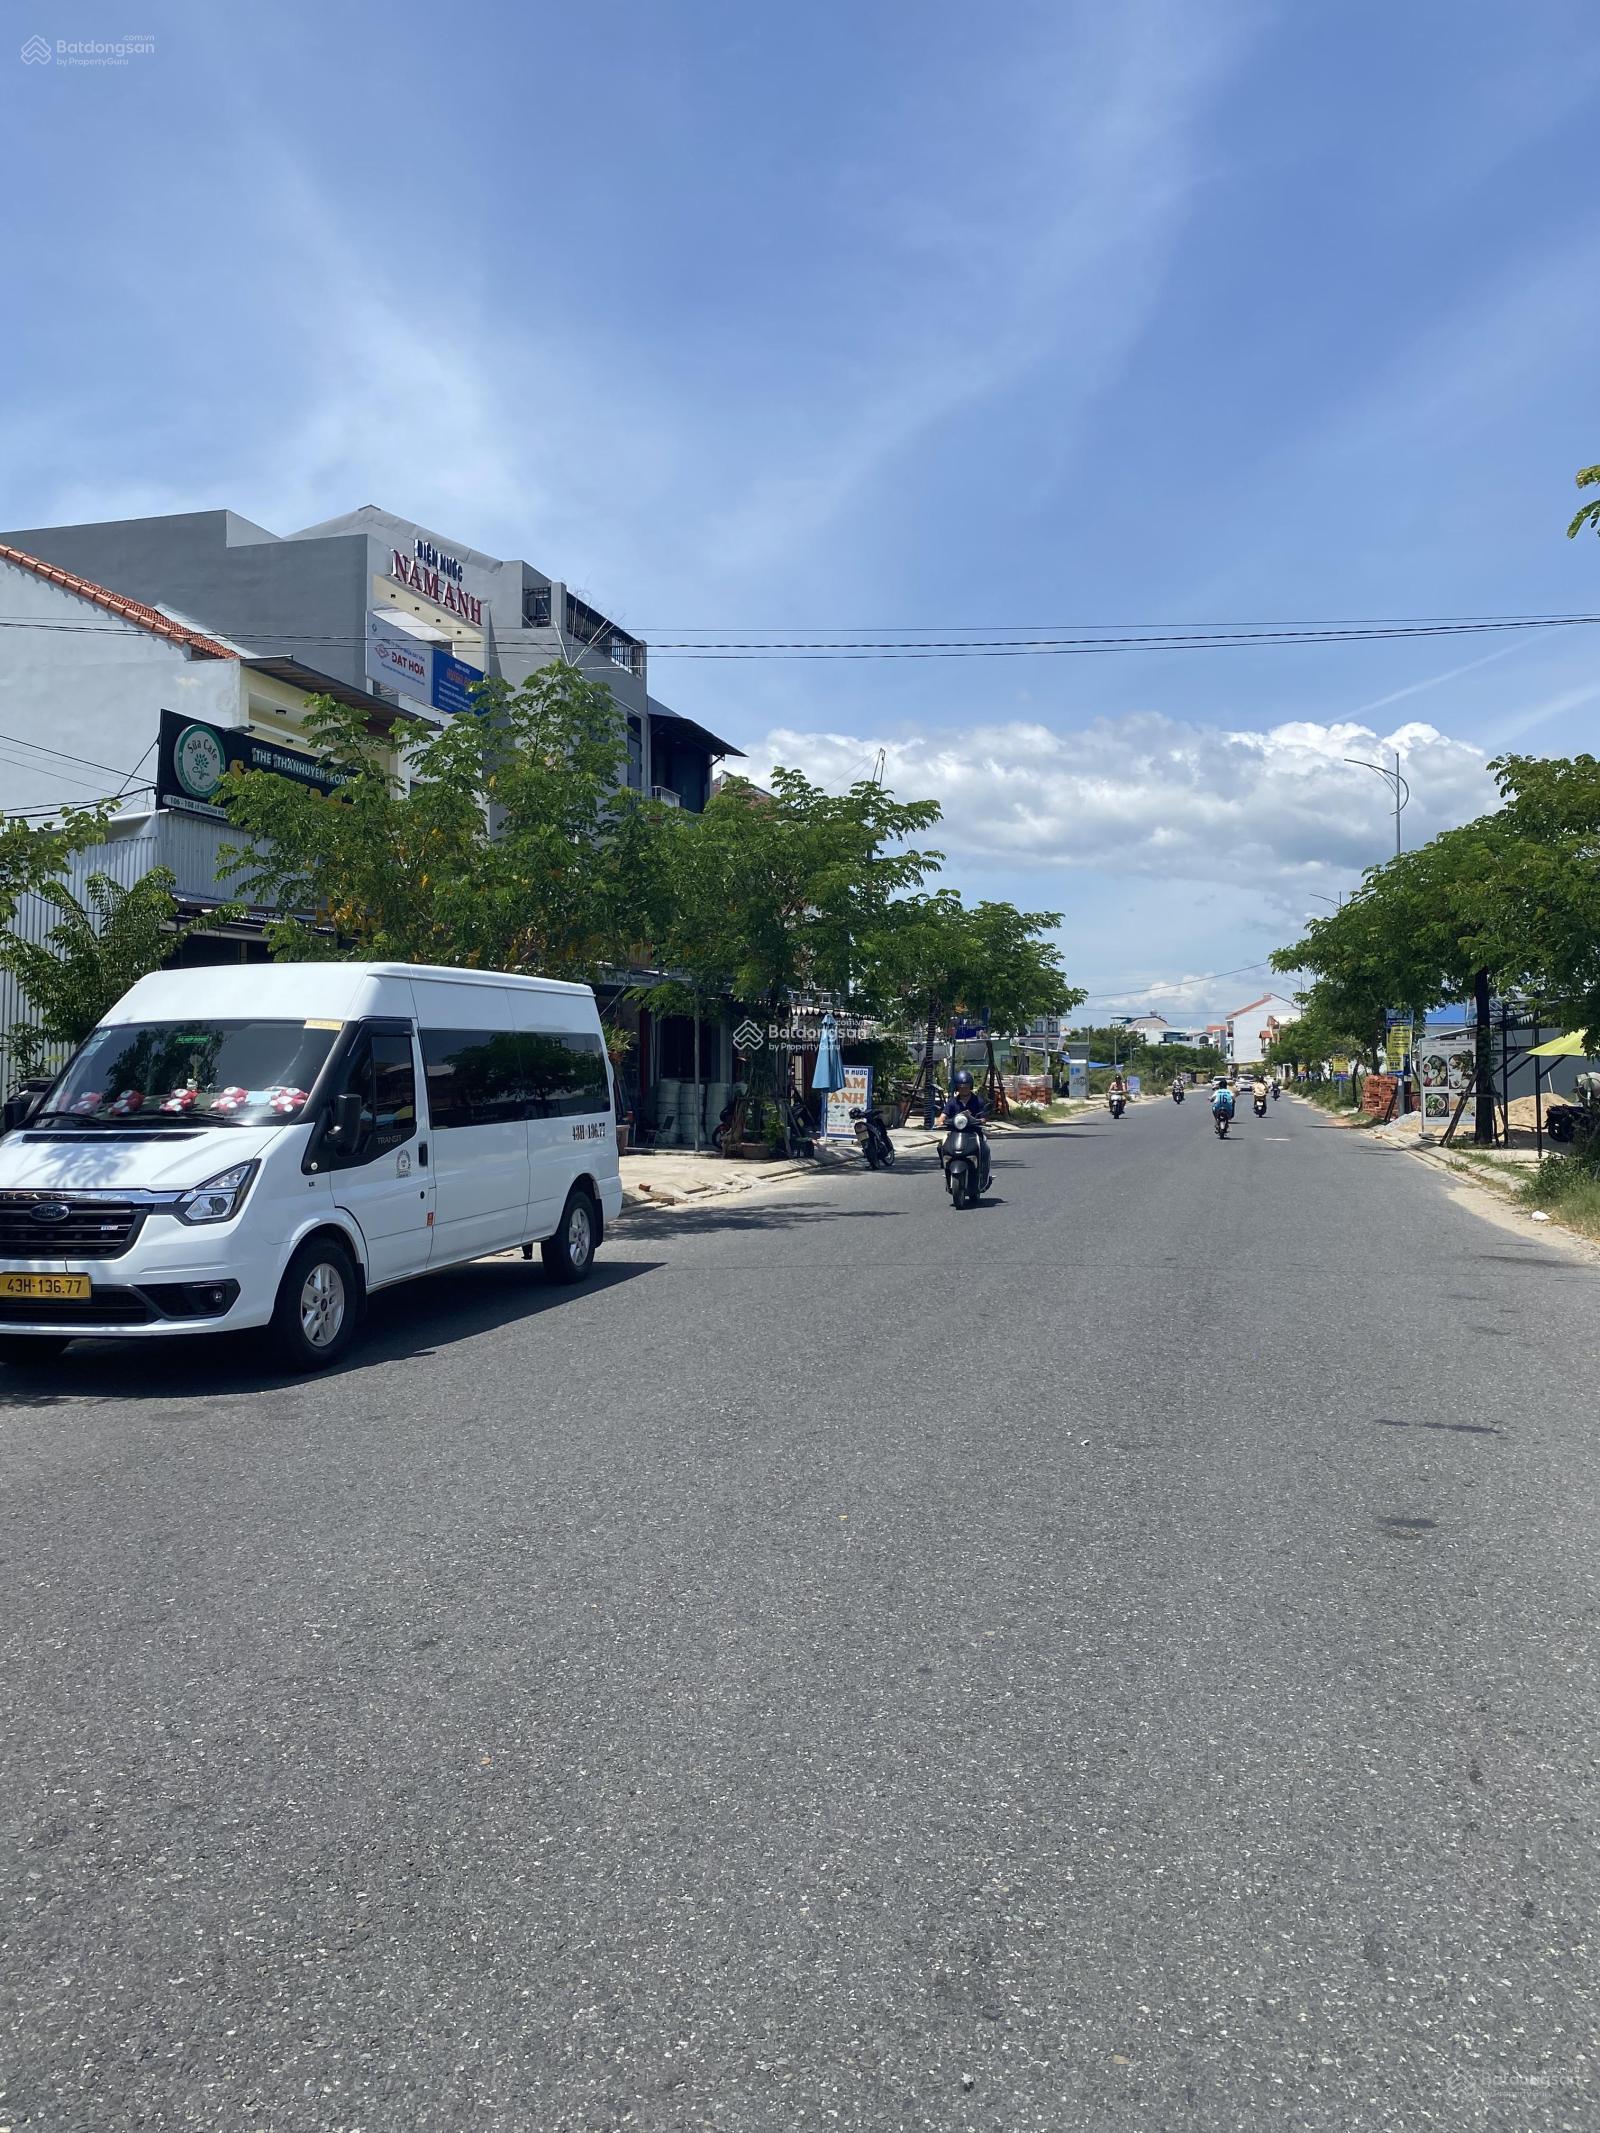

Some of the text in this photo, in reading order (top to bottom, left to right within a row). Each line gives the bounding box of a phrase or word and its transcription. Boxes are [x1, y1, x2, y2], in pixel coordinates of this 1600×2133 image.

[389, 549, 482, 626] NAM ANH
[253, 747, 272, 765] THE
[828, 1091, 865, 1104] ANH
[1219, 1093, 1228, 1103] 16
[376, 1134, 402, 1145] TRANSIT
[7, 1278, 82, 1294] 43H-136.77
